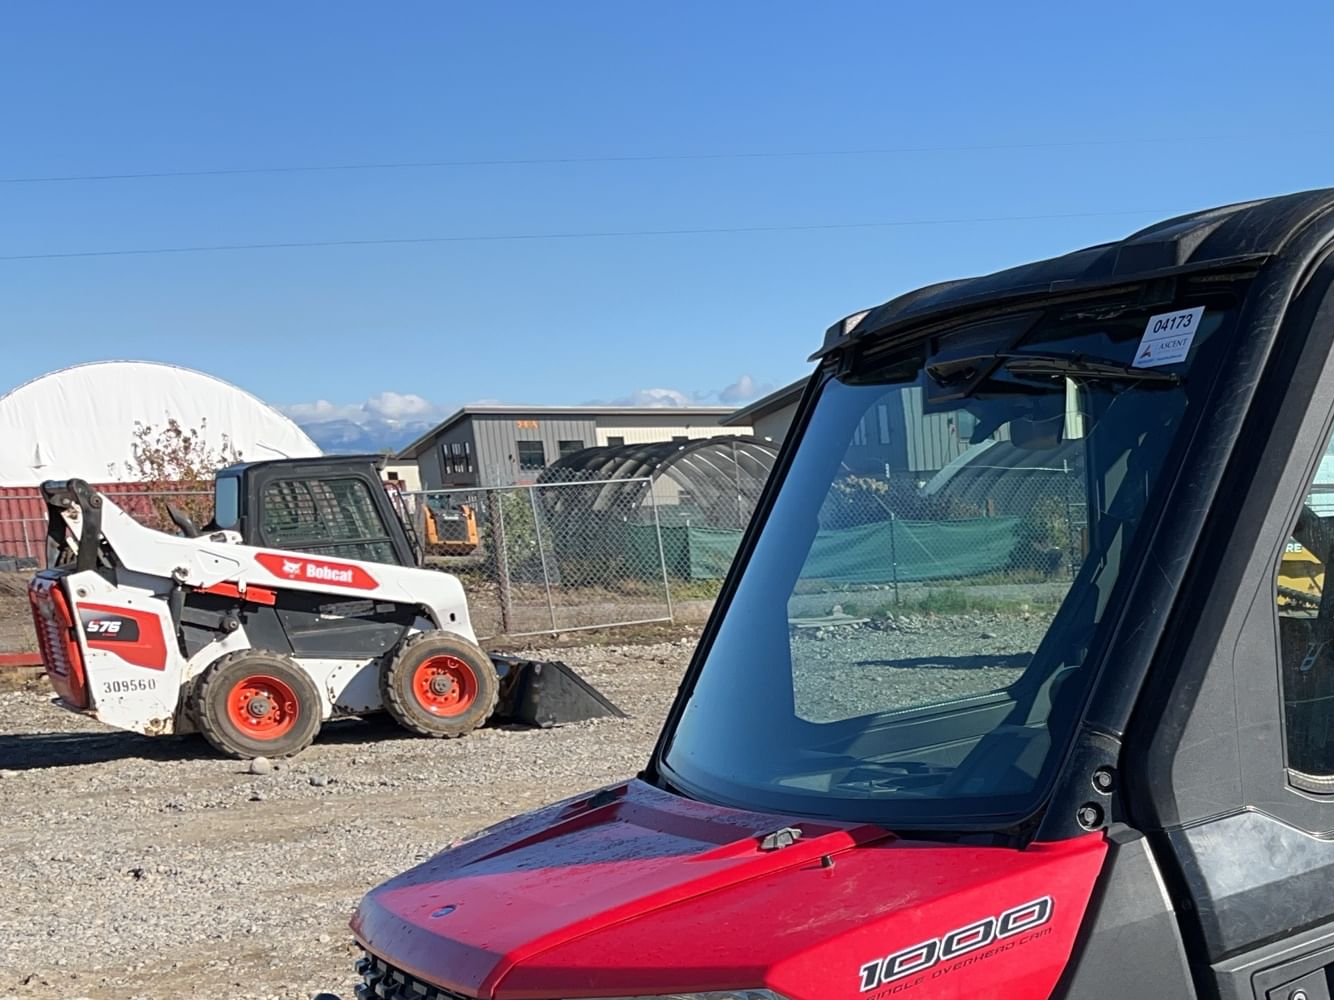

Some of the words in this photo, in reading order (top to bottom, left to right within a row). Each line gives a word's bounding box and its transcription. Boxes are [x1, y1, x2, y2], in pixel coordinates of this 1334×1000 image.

[1153, 313, 1193, 333] 04173
[1160, 337, 1189, 349] ASCENT
[306, 563, 353, 583] Bobcat
[87, 620, 122, 633] S76
[103, 678, 156, 693] 309560
[858, 894, 1055, 993] 1000
[931, 942, 1015, 980] OVERHEAD
[1019, 926, 1053, 945] CAM
